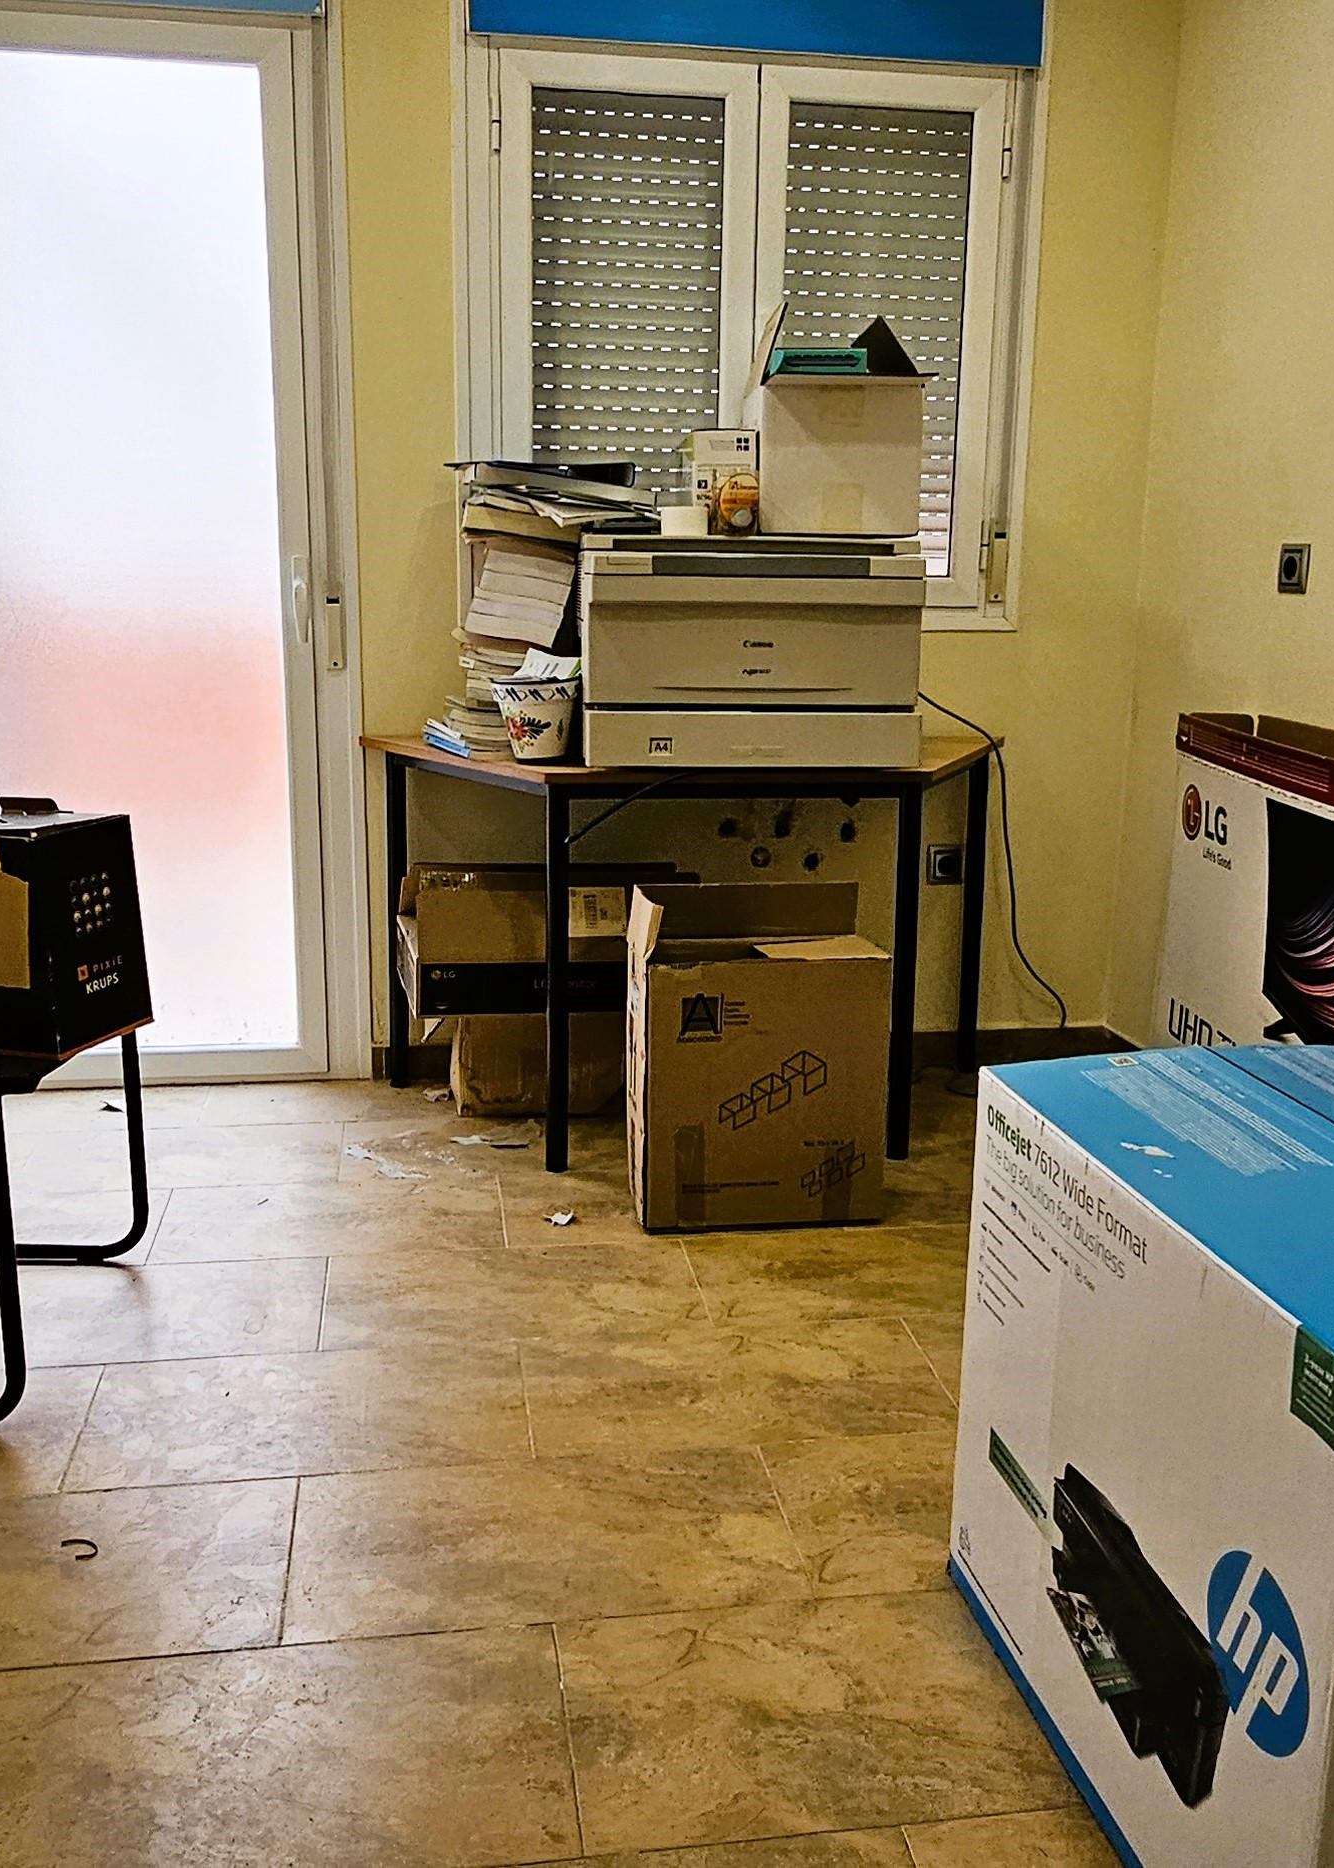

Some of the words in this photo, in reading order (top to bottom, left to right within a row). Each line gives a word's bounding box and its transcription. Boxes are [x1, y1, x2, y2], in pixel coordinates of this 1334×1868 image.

[654, 742, 669, 752] A4
[1204, 800, 1228, 846] LG
[1217, 852, 1232, 871] Good
[92, 955, 123, 974] PIXIE
[443, 971, 456, 979] LG
[85, 972, 120, 995] KRUPS
[1168, 997, 1213, 1047] UHD
[987, 1104, 1032, 1162] Officejet
[1034, 1143, 1061, 1188] 7612
[1063, 1168, 1094, 1217] Wide
[1097, 1197, 1147, 1265] Format
[1018, 1169, 1056, 1215] solution
[1074, 1215, 1126, 1280] business
[1215, 1551, 1300, 1732] hp
